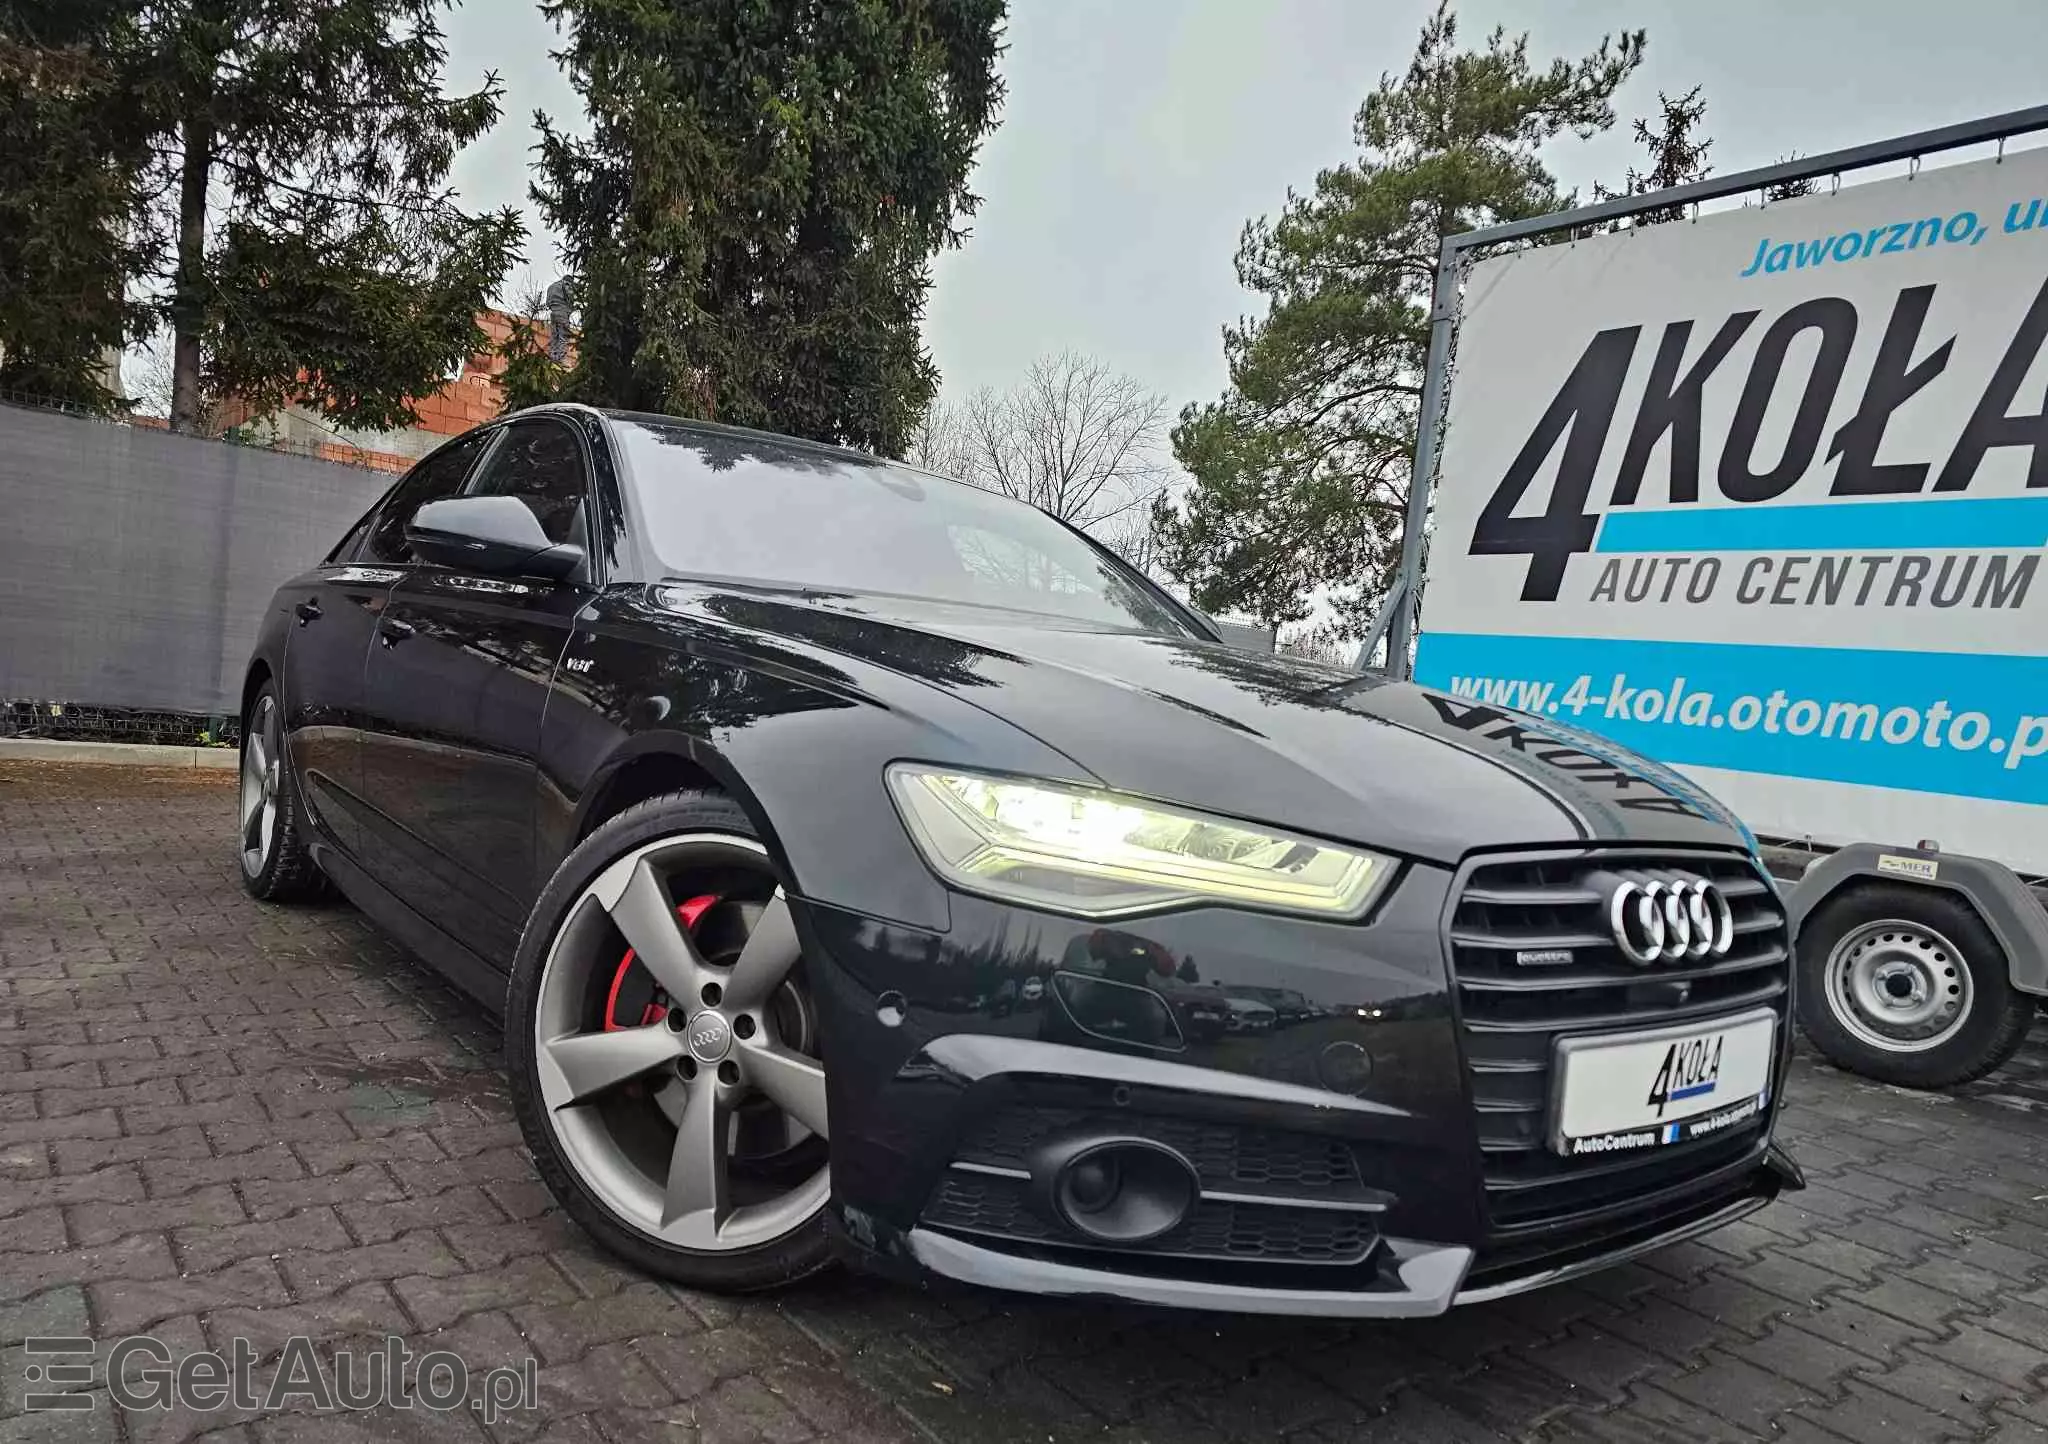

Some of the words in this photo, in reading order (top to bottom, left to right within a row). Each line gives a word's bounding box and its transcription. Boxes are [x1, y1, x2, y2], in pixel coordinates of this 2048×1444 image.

[1740, 210, 1989, 277] Jaworzno,
[1468, 275, 2048, 602] 4KOŁA
[1590, 557, 1721, 603] AUTO
[1736, 554, 2041, 609] CENTRUM
[1573, 1132, 1656, 1154] AutoCentrum
